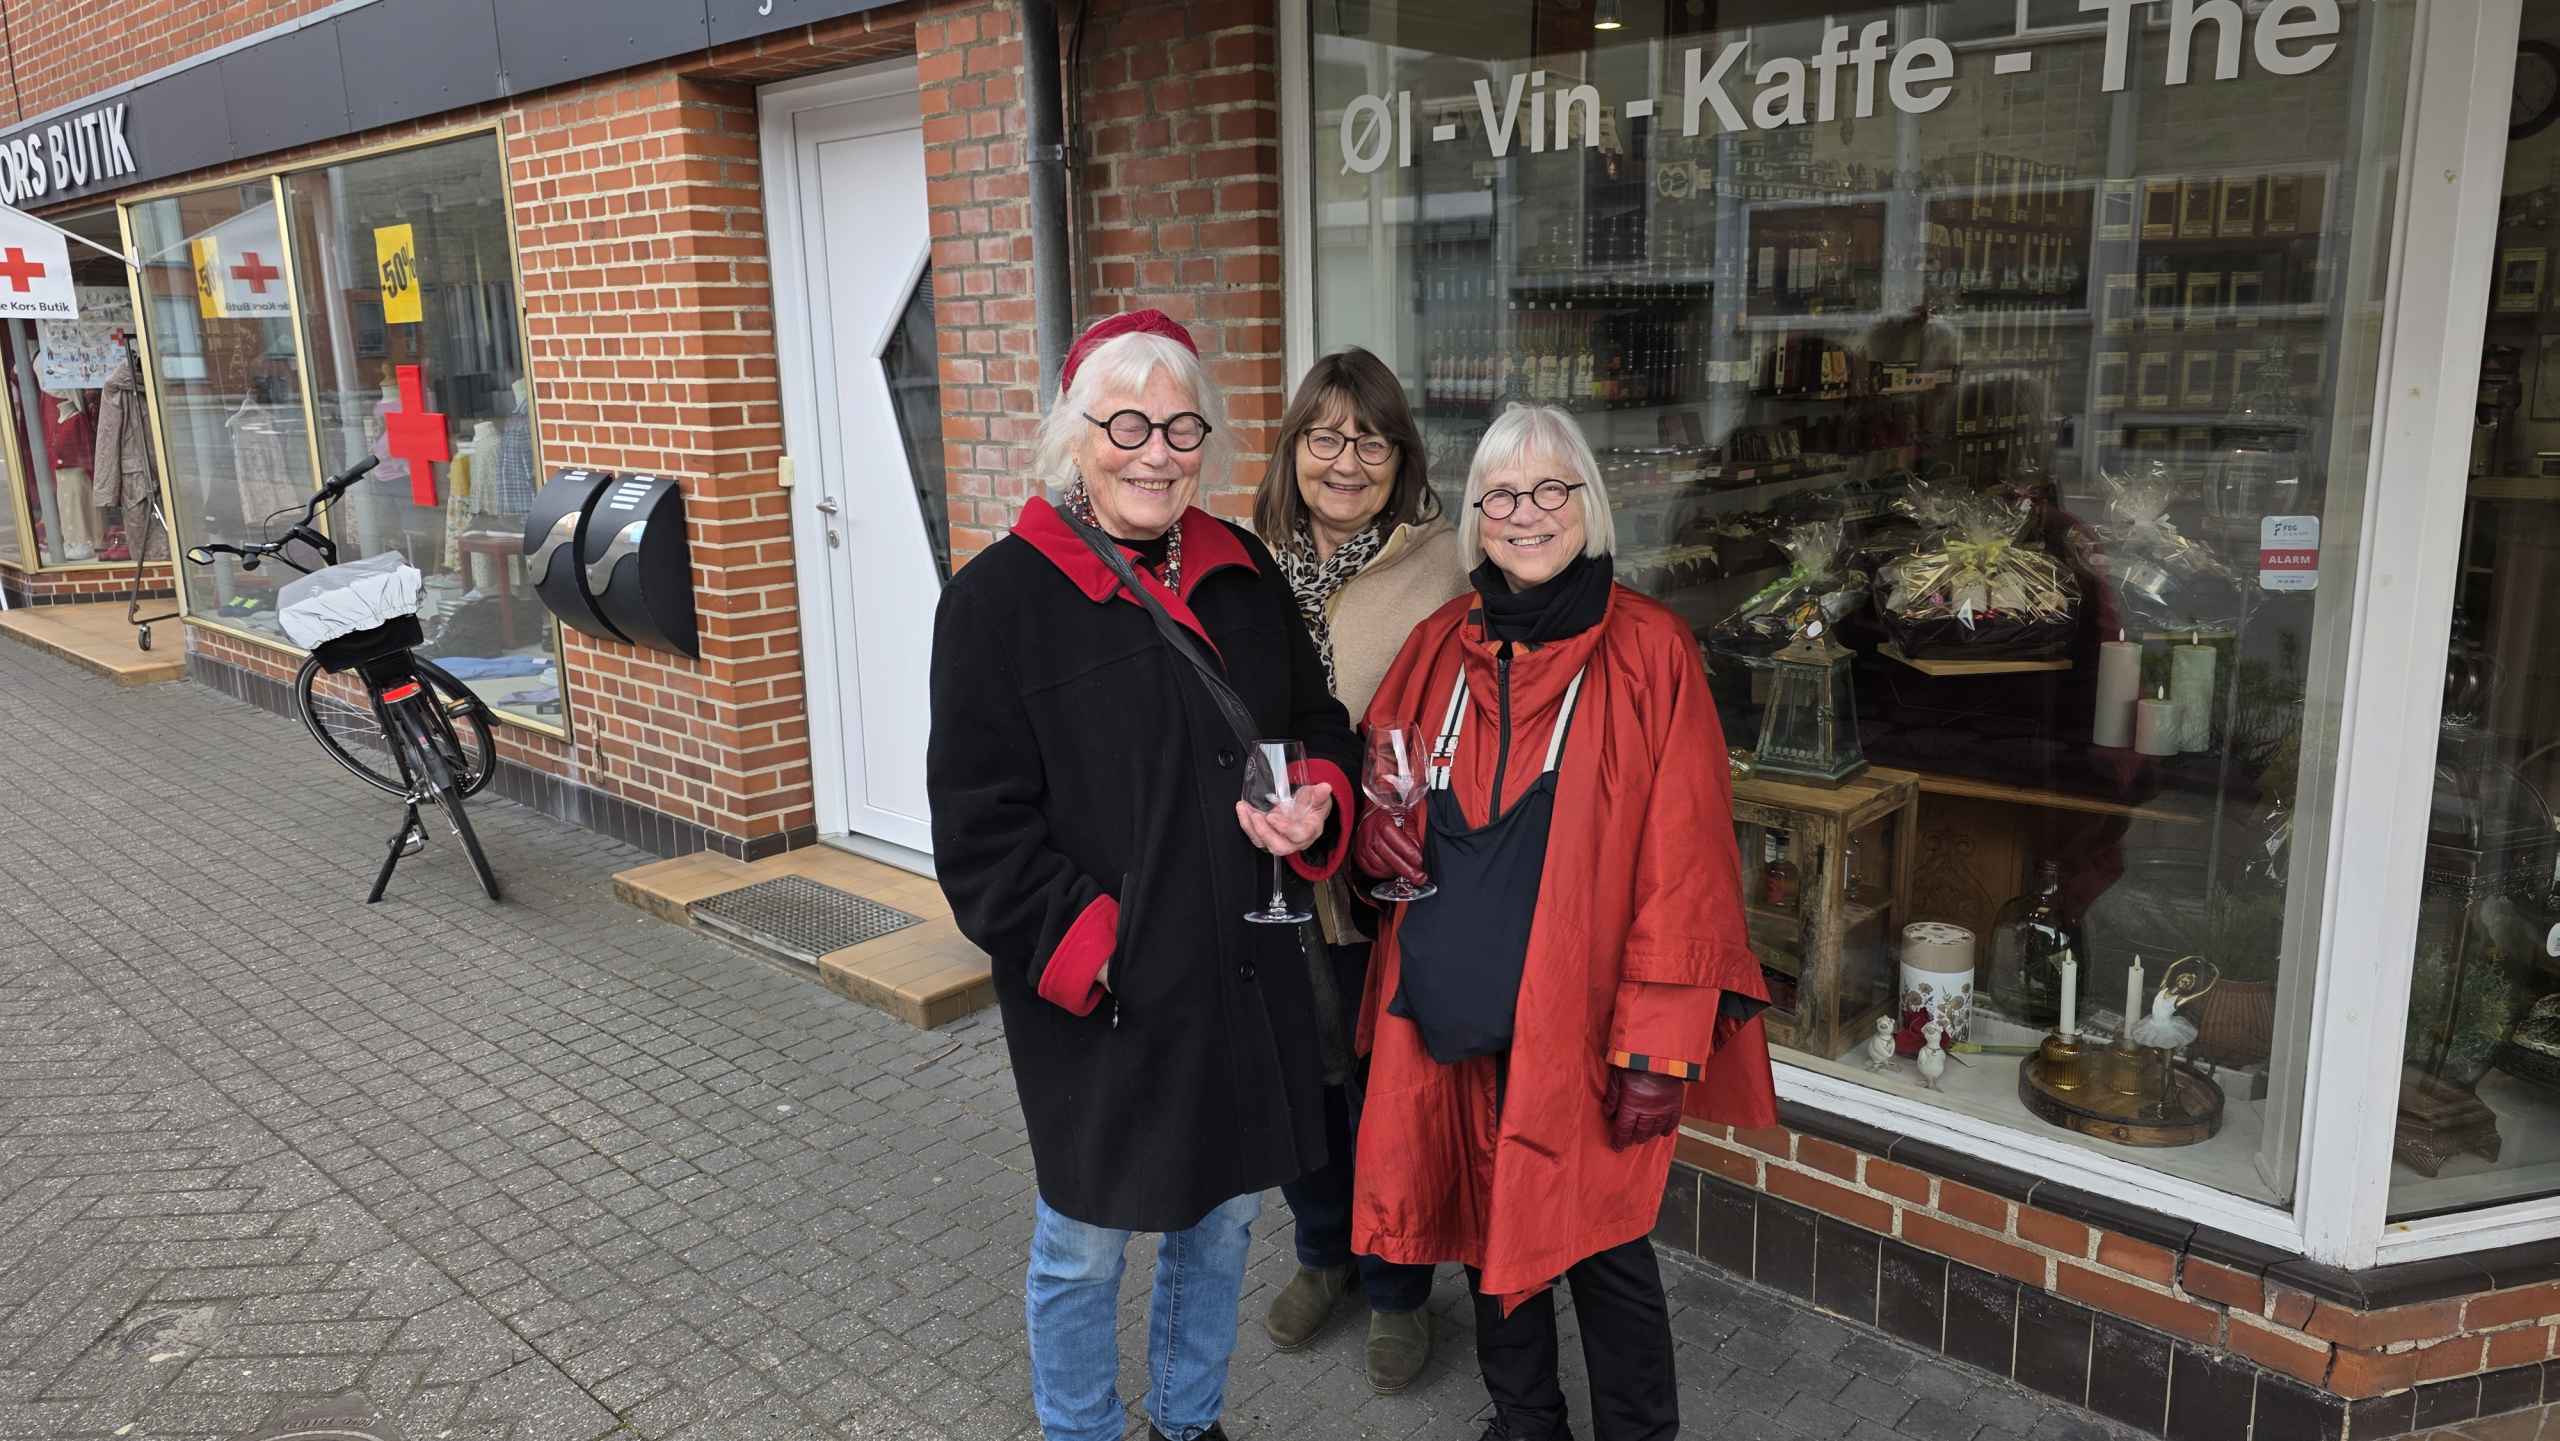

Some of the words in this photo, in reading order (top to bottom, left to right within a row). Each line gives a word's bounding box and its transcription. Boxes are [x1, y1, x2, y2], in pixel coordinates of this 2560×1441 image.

[1339, 90, 1412, 177] Øl
[1474, 71, 1600, 157] Vin
[1683, 20, 1954, 137] Kaffe
[2078, 0, 2341, 92] The
[0, 133, 47, 206] ORS
[47, 103, 136, 189] BUTIK
[11, 301, 36, 311] Kors
[39, 303, 70, 312] Butik
[2268, 555, 2311, 565] ALARM
